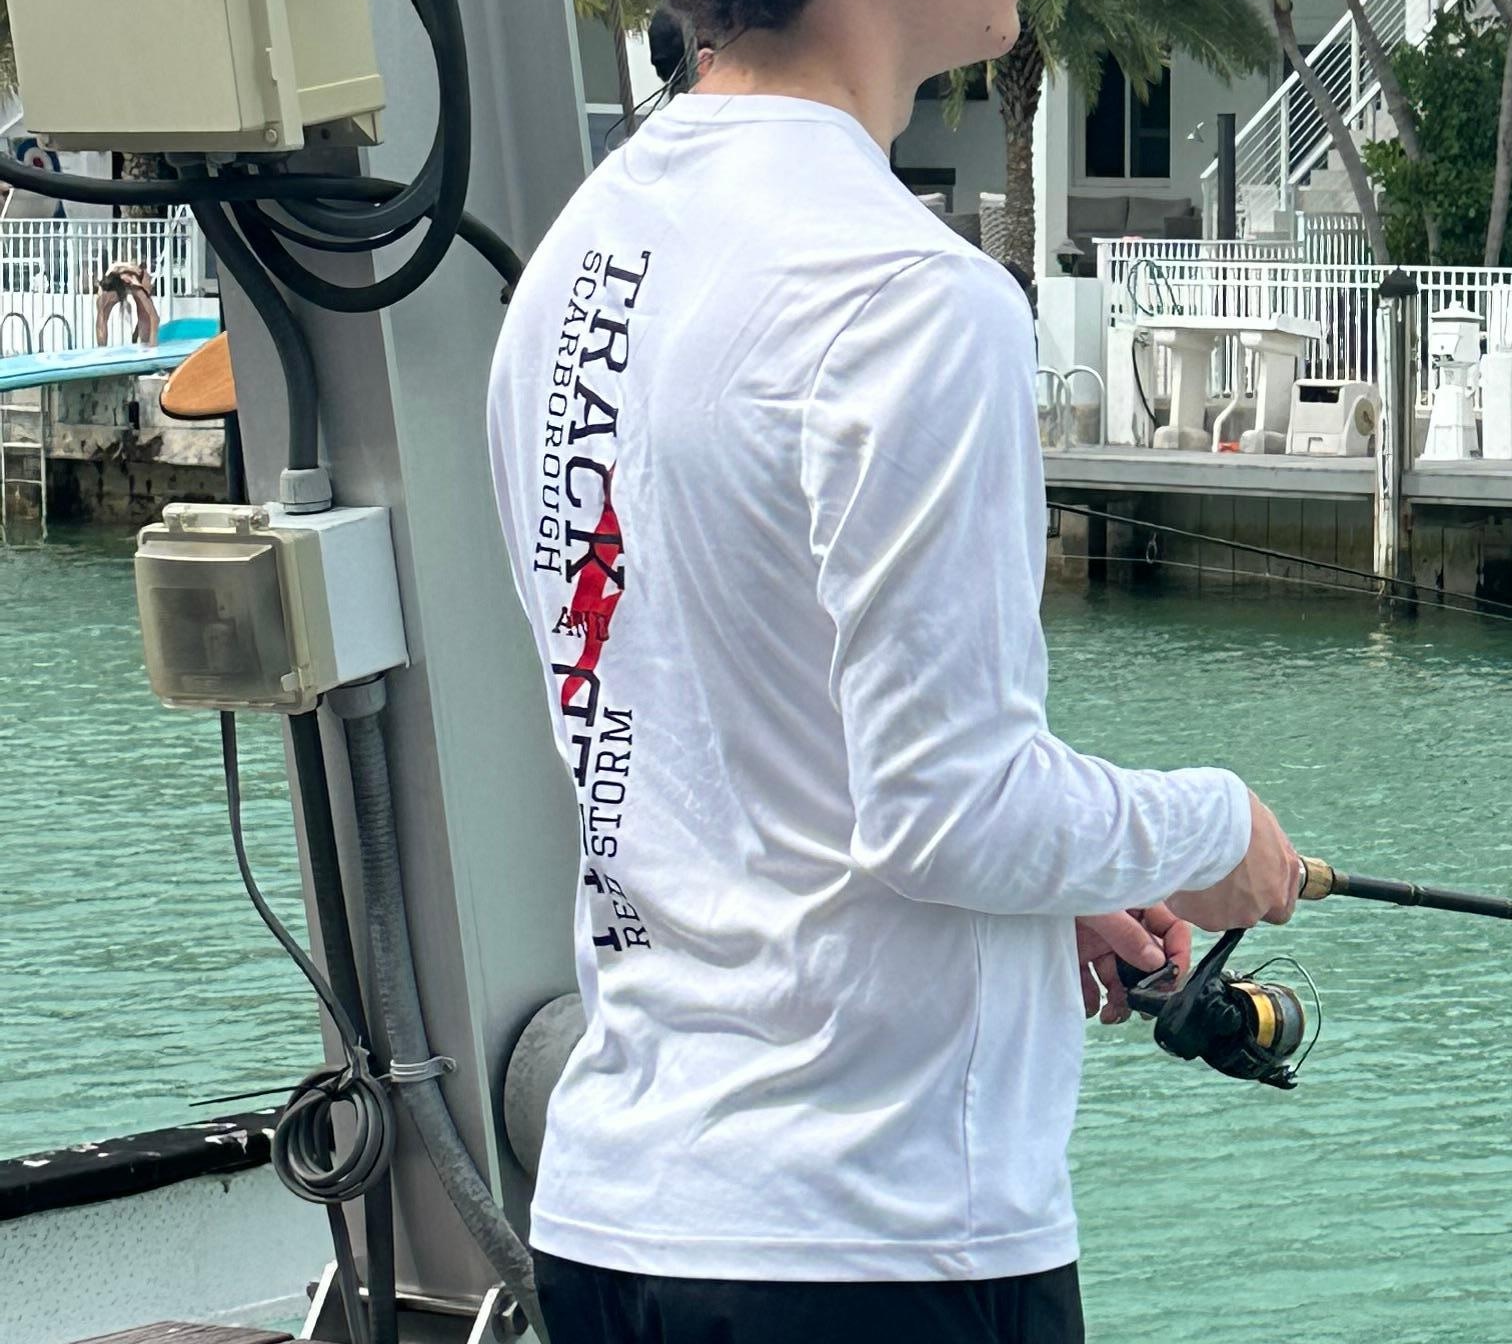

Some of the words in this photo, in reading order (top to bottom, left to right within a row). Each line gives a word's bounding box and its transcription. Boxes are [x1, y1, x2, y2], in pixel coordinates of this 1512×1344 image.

[533, 249, 602, 577] SCARBOROUGH
[564, 250, 652, 591] TRACK
[590, 706, 633, 858] STORM
[602, 872, 651, 949] RED
